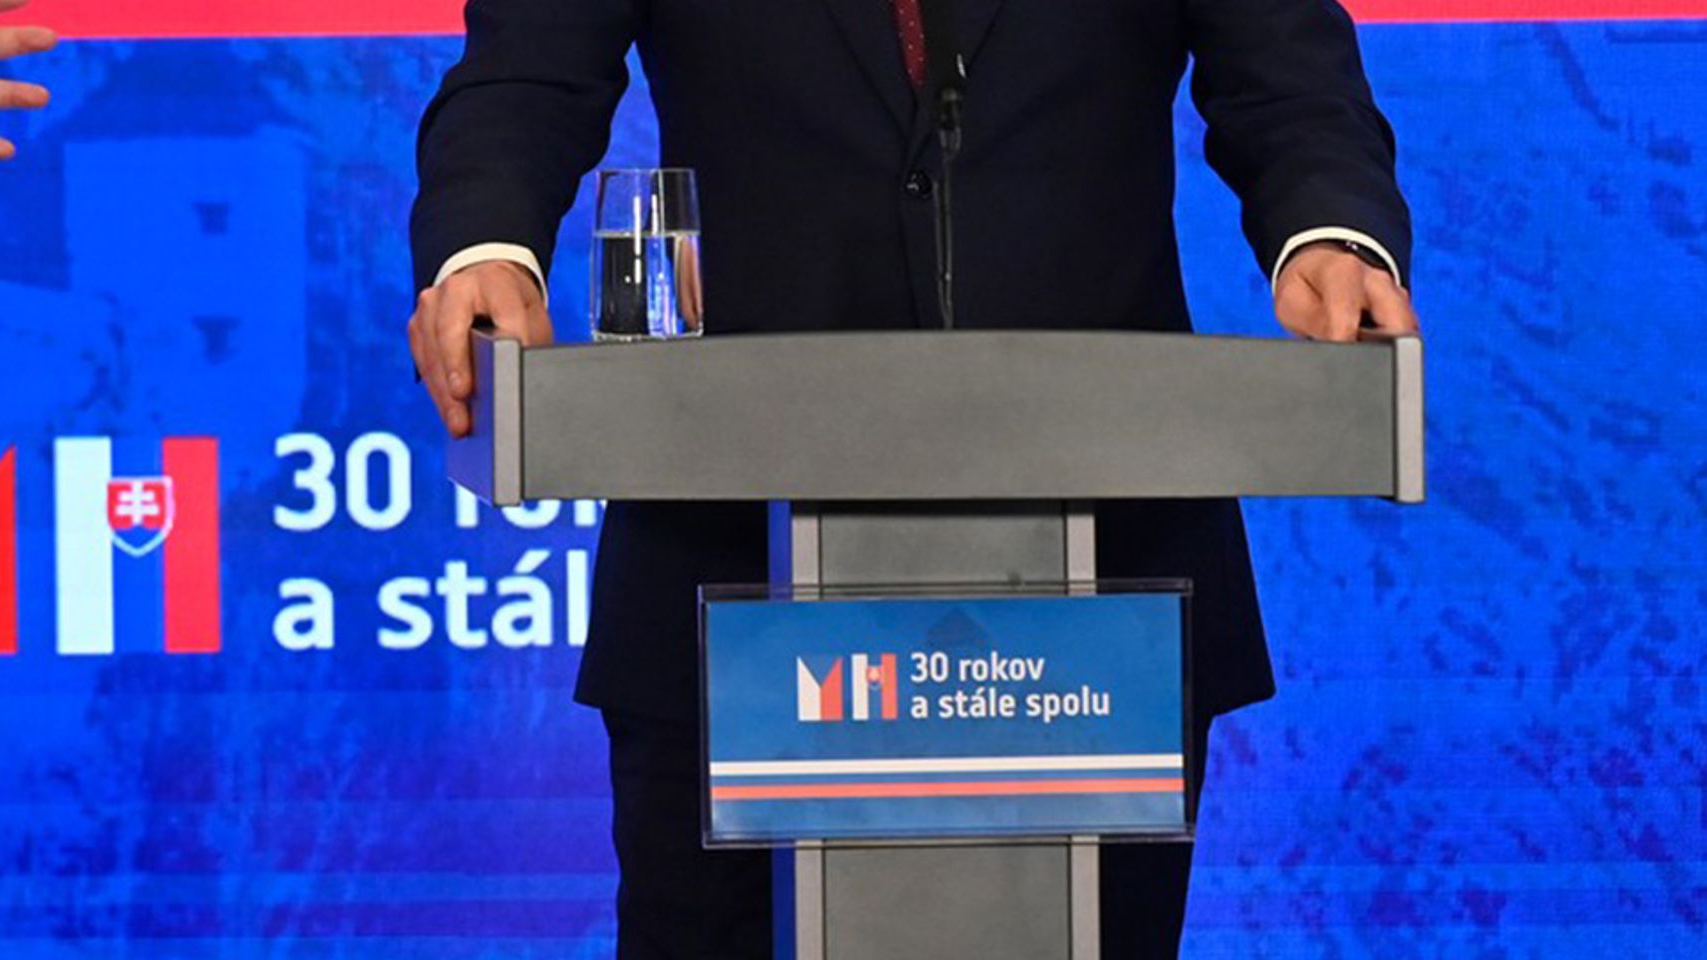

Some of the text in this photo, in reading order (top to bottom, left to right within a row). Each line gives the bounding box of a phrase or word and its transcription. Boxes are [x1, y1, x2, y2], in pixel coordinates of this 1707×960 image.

[274, 432, 412, 531] 30
[272, 577, 334, 650] a
[911, 651, 1045, 683] 30 rokov
[911, 685, 1110, 723] a stále spolu
